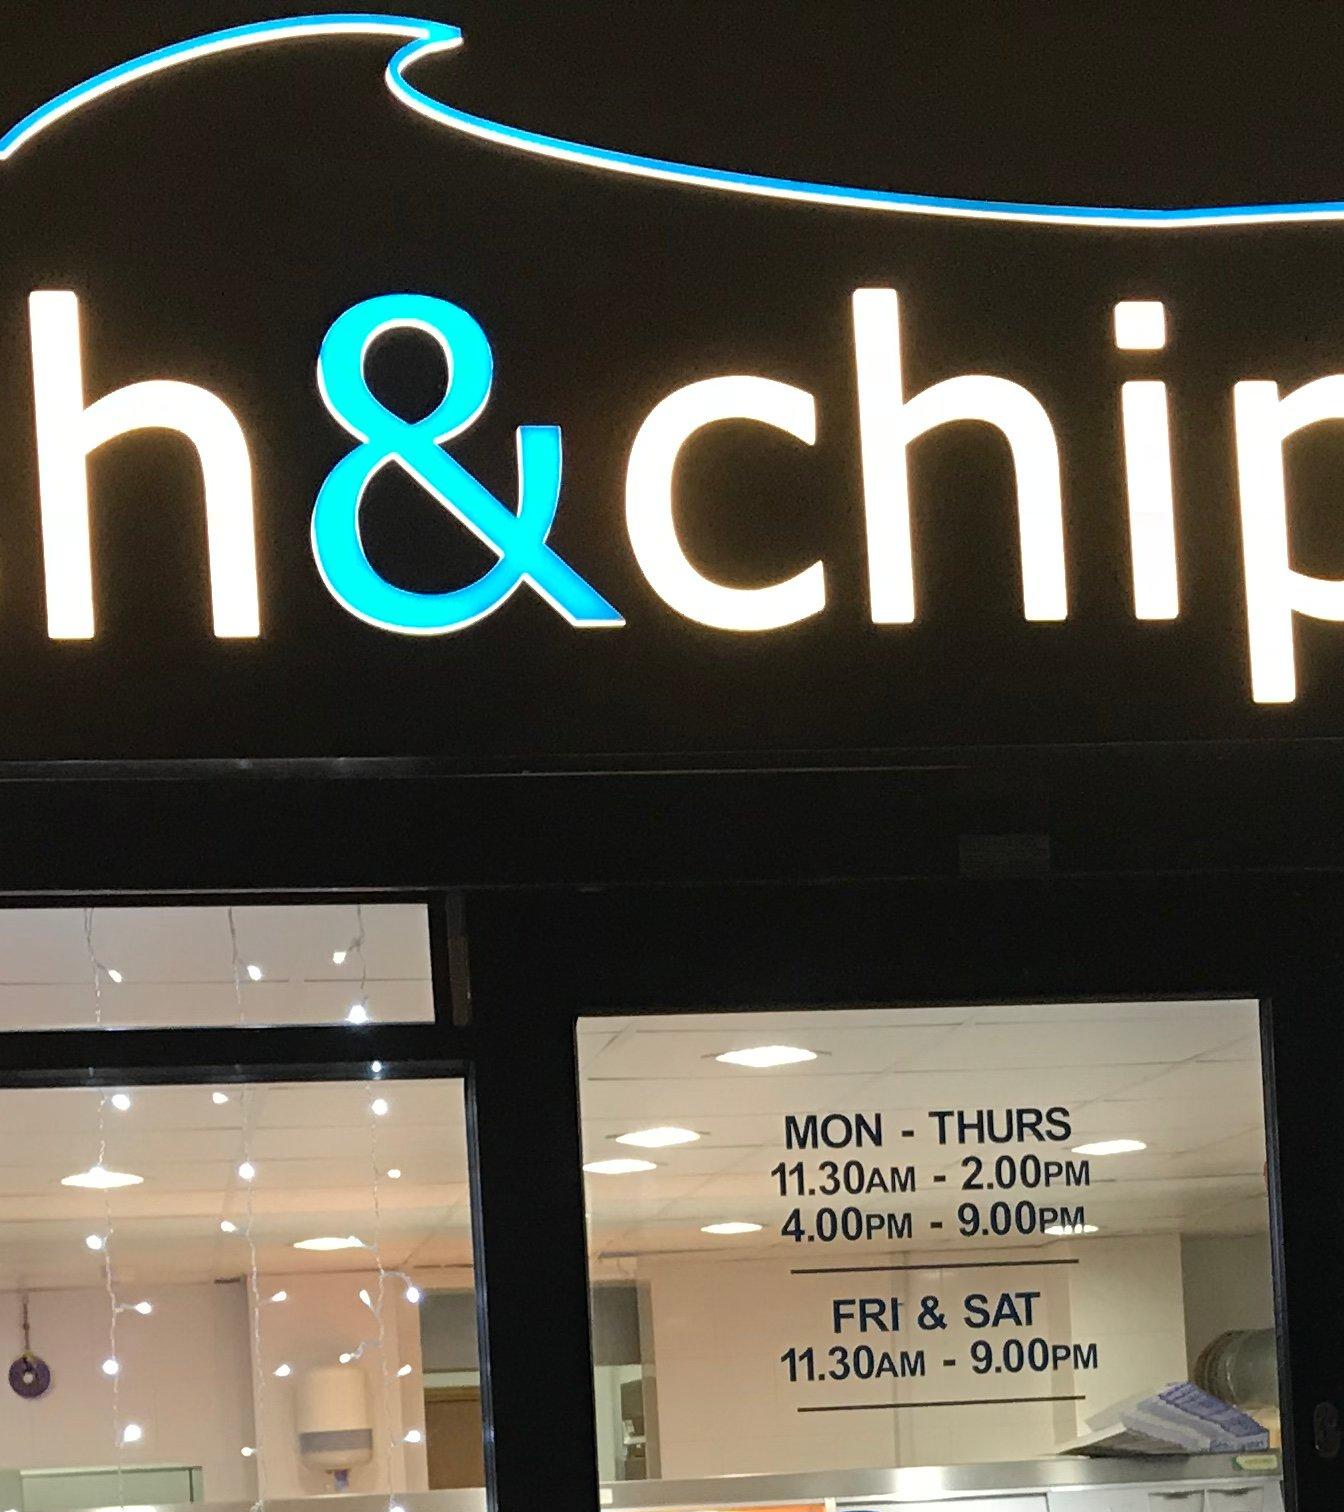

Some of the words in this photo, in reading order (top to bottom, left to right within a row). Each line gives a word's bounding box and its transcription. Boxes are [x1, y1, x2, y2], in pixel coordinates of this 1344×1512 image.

[784, 1112, 884, 1150] MON
[927, 1106, 1073, 1146] THURS
[770, 1159, 917, 1198] 11.30AM
[960, 1154, 1091, 1192] 2.00PM
[780, 1206, 914, 1244] 4.00PM
[956, 1200, 1086, 1239] 9.00PM
[831, 1296, 904, 1335] FRI
[916, 1295, 949, 1331] &
[962, 1291, 1042, 1329] SAT
[779, 1345, 927, 1383] 11.30AM
[969, 1337, 1099, 1375] 9.00PM
